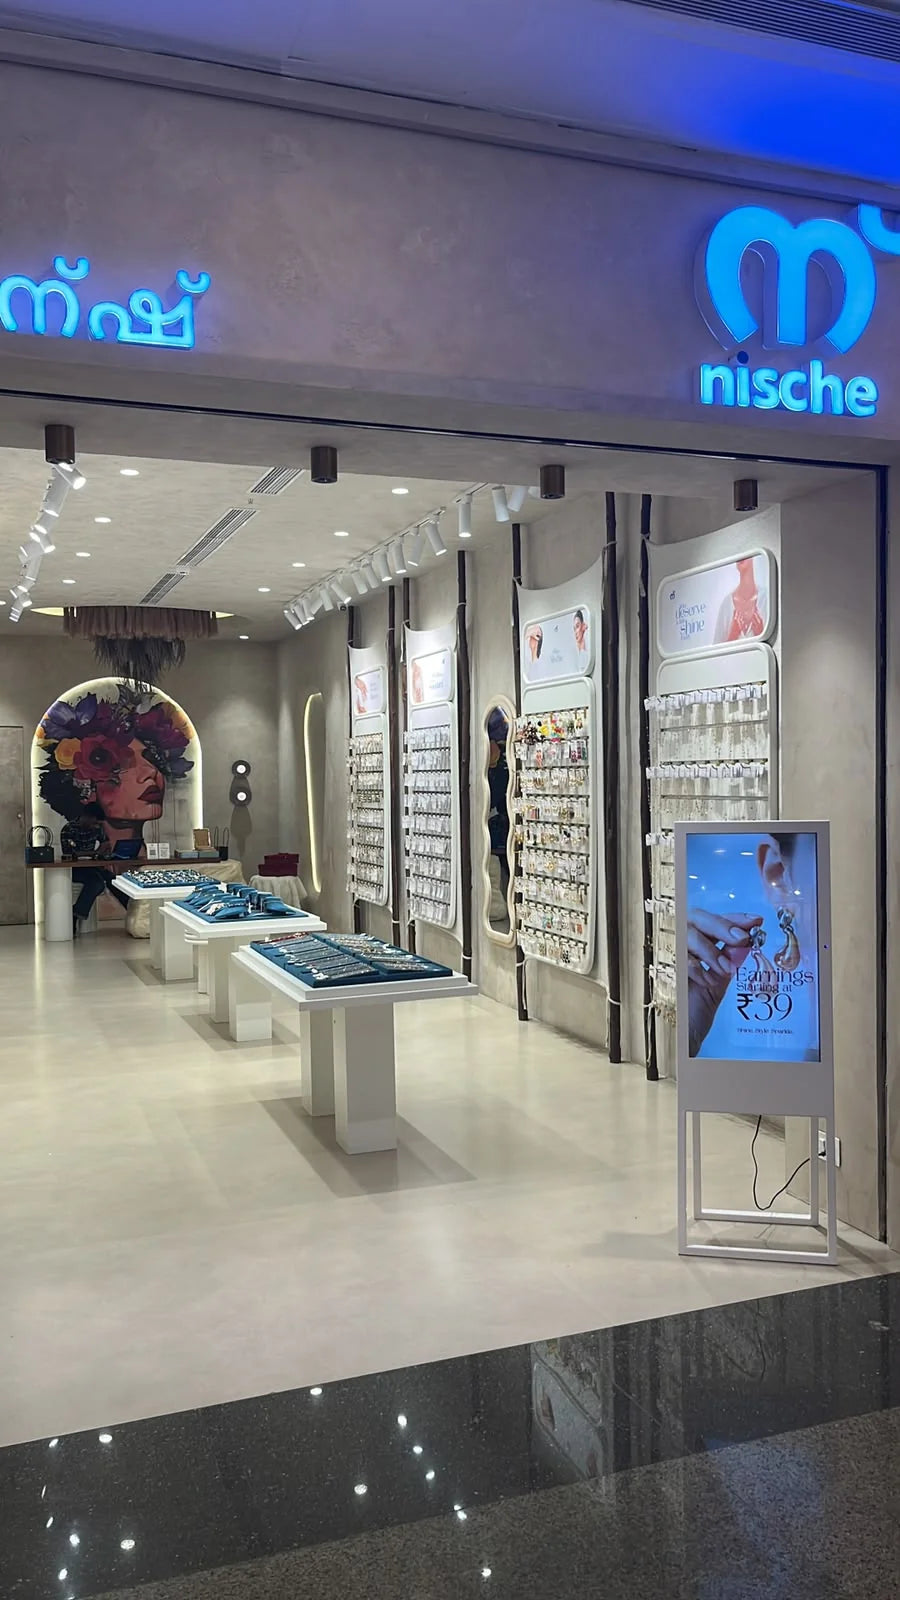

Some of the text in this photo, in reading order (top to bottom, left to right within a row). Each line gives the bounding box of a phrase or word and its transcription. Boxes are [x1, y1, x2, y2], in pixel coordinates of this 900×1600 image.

[700, 352, 878, 417] nische
[736, 967, 814, 987] Earrings
[736, 982, 792, 993] Starting at
[736, 992, 793, 1021] ₹39
